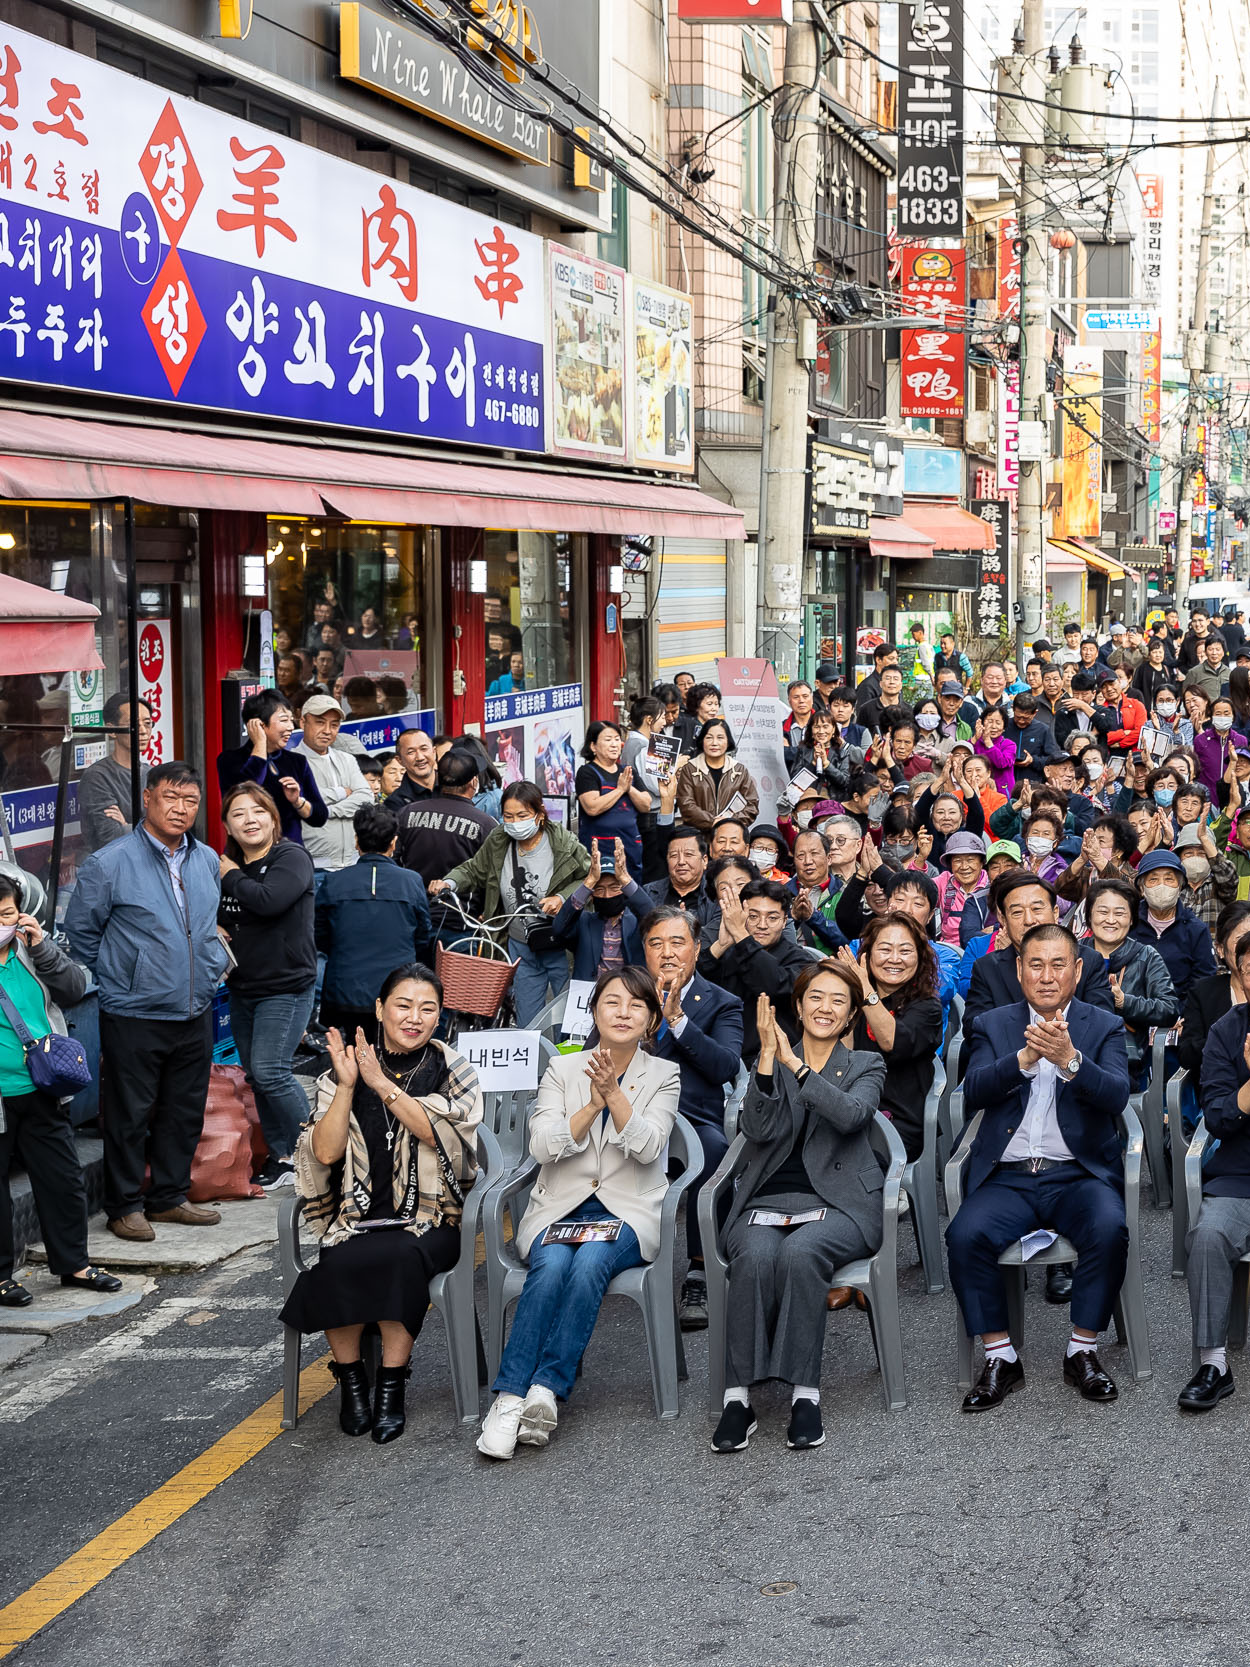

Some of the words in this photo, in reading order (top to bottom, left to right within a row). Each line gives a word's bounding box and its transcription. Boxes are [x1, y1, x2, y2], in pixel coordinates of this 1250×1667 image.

[372, 27, 430, 97] Nine
[512, 109, 544, 149] Bar
[904, 120, 957, 148] HOF
[899, 166, 961, 193] 463-
[900, 198, 958, 225] 1833
[125, 211, 151, 264] 구
[217, 136, 524, 321] 羊肉串
[554, 262, 570, 282] KBS
[226, 276, 477, 428] 양꼬치구이
[483, 361, 539, 397] 건대직영점
[484, 398, 539, 428] 467-6880
[140, 638, 163, 667] 원조
[407, 811, 444, 830] MAN
[446, 815, 481, 841] UTD
[469, 1047, 529, 1068] 내빈석
